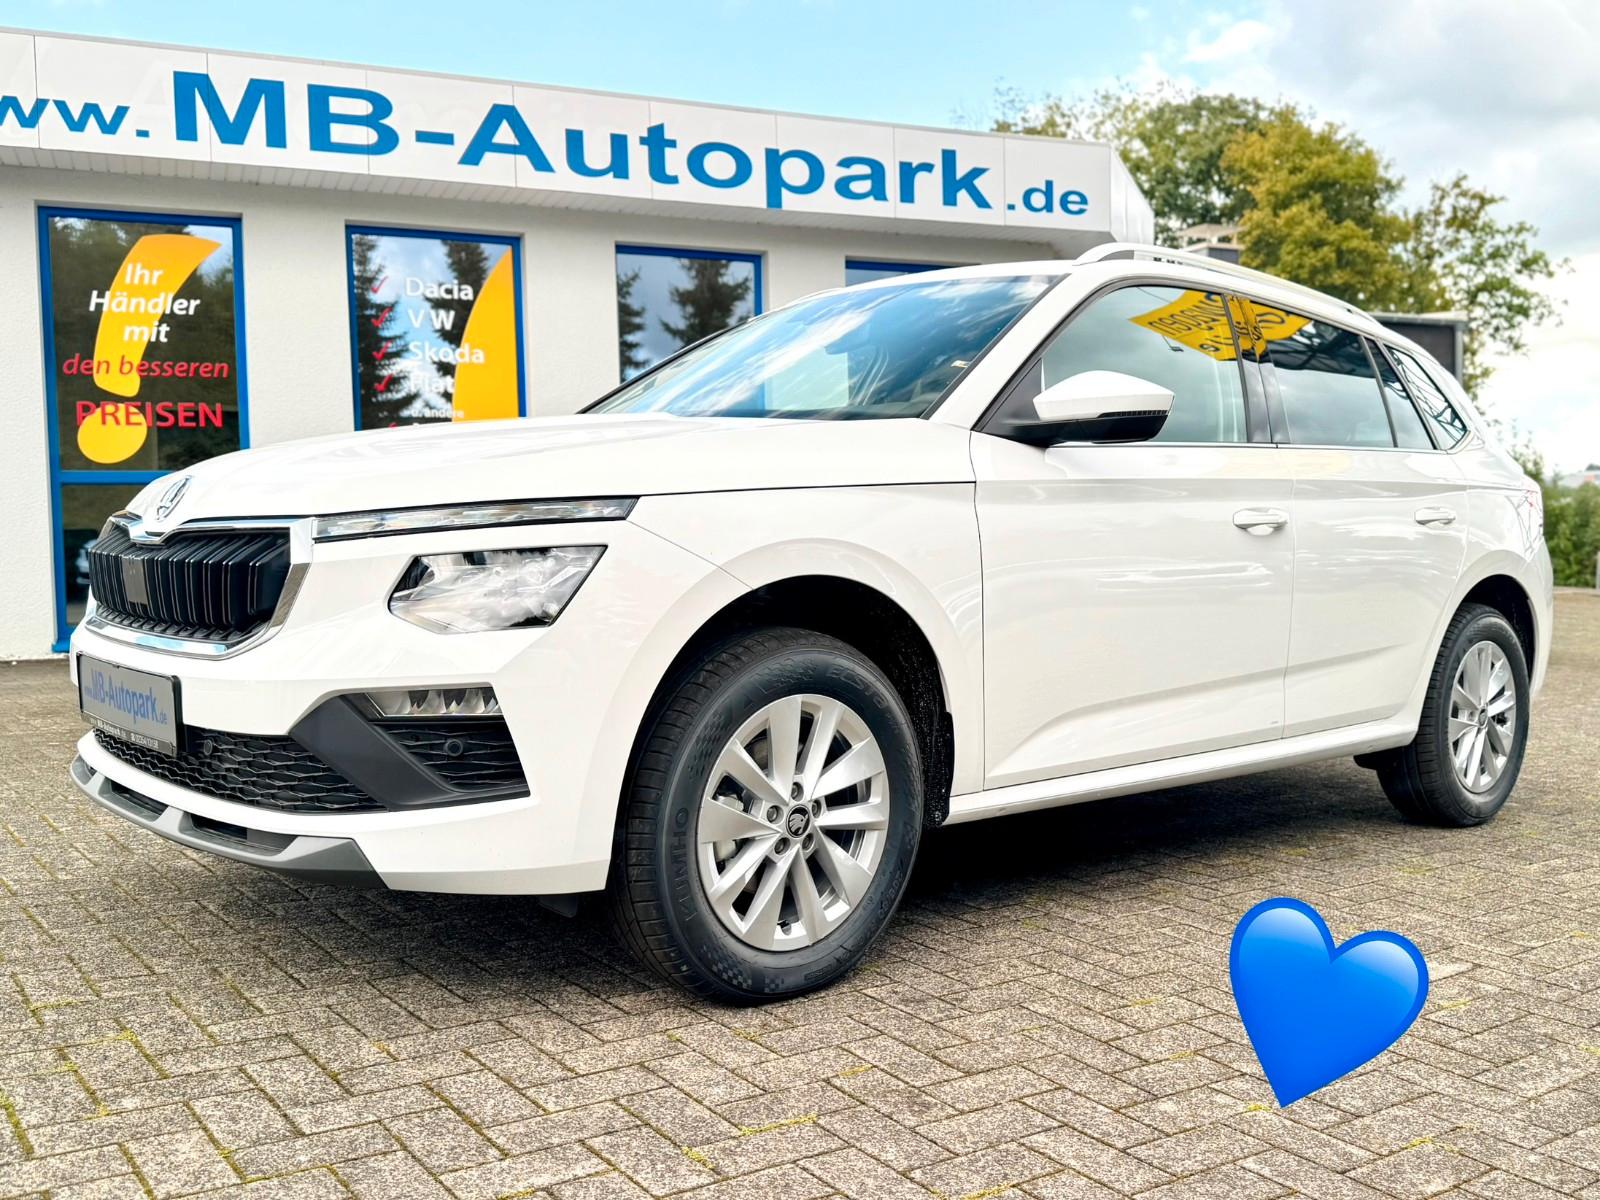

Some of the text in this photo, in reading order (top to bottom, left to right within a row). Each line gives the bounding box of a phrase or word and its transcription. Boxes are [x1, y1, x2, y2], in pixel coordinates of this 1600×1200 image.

[125, 263, 164, 286] Ihr
[405, 276, 474, 300] Dacia
[89, 290, 200, 316] Händler
[123, 321, 170, 343] mit
[408, 340, 486, 365] Skoda
[62, 353, 230, 378] den besseren
[76, 400, 223, 428] PREISEN
